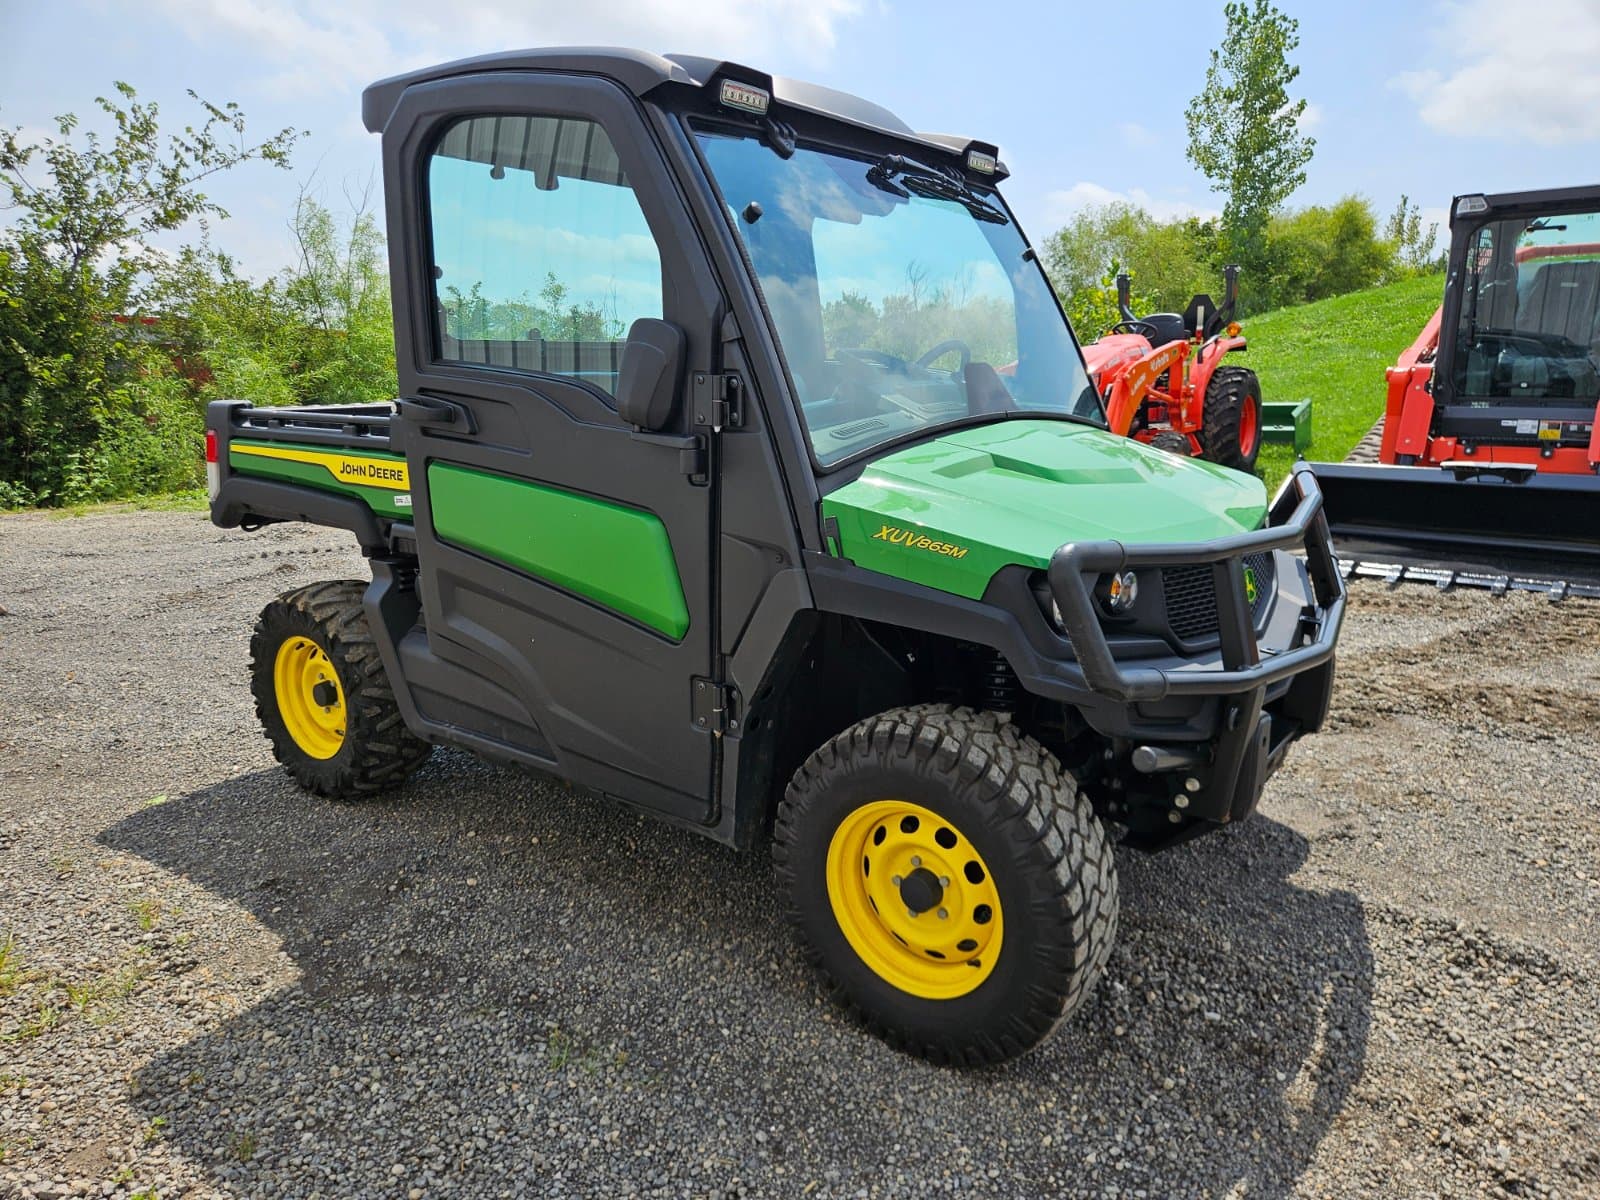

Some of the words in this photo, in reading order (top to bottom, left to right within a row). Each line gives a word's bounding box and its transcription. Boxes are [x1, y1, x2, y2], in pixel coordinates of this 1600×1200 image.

[340, 461, 366, 476] JOHN
[368, 464, 404, 481] DEERE
[872, 525, 968, 559] XUV865M
